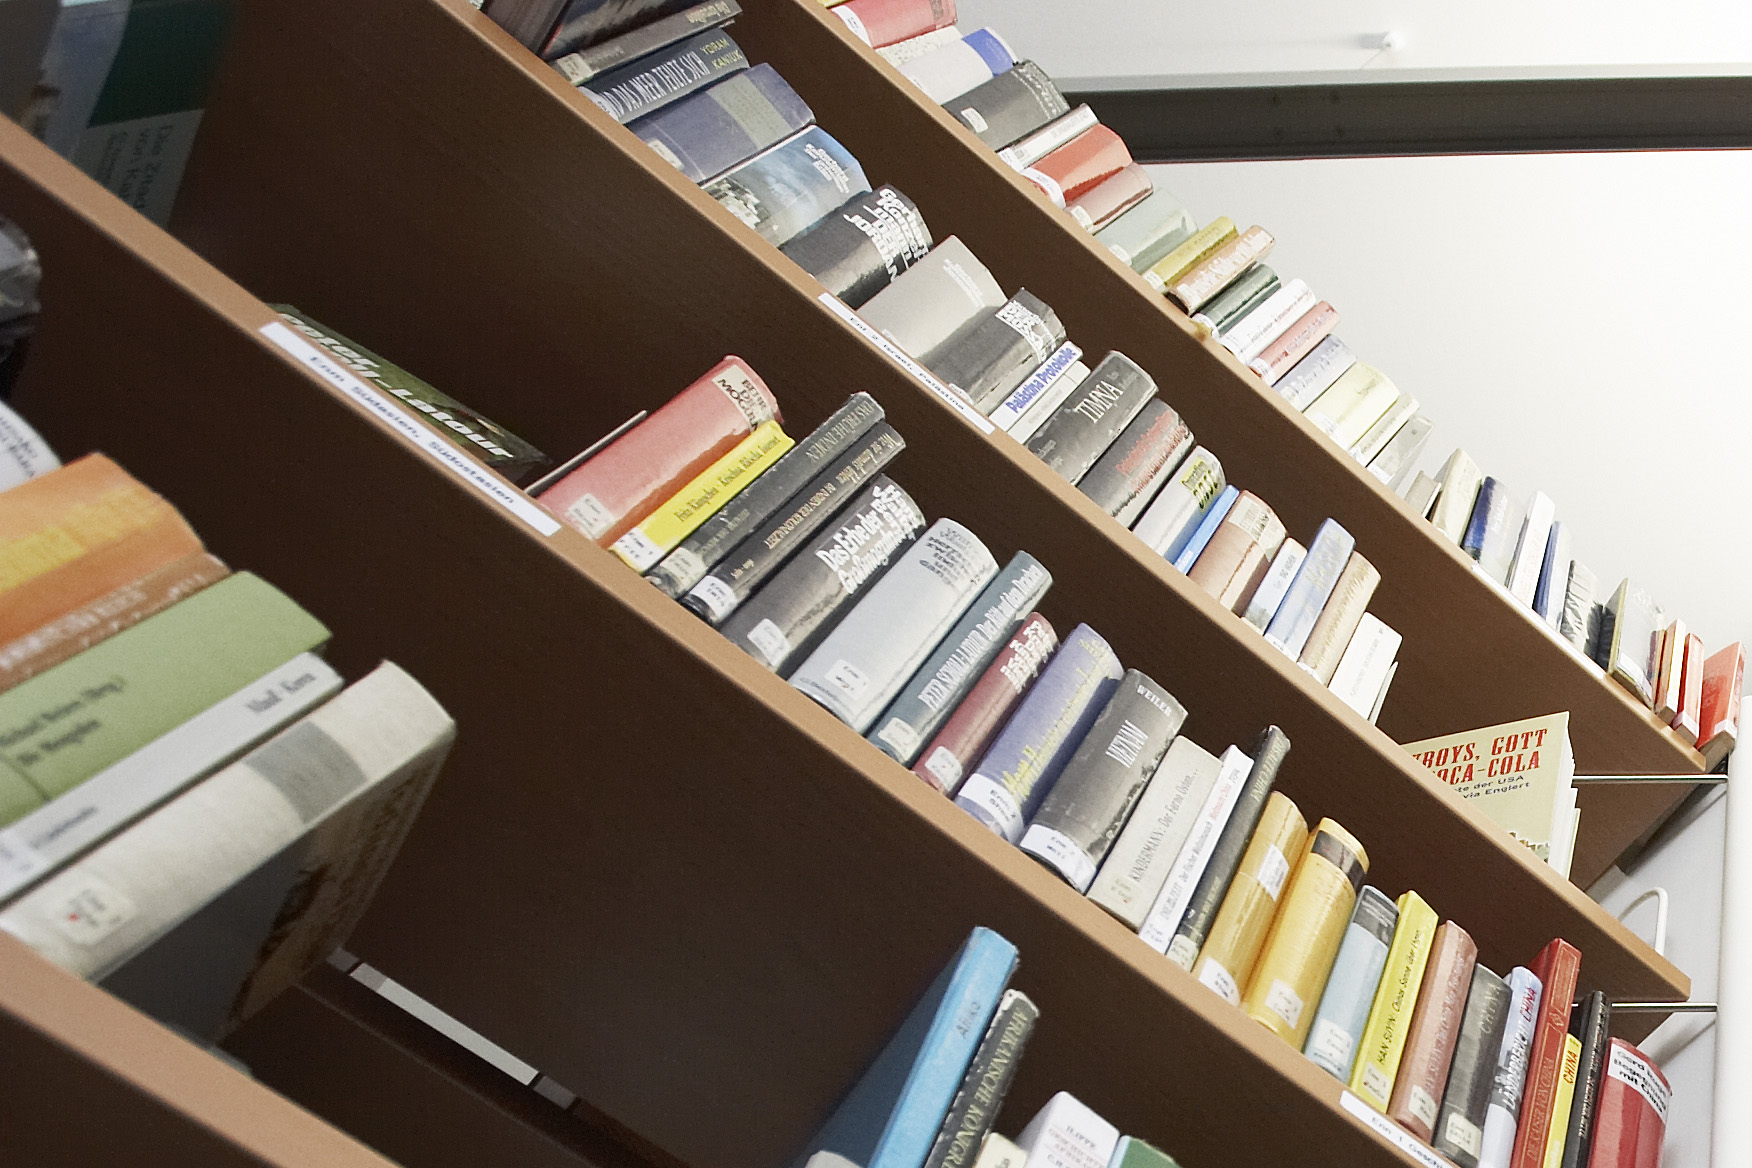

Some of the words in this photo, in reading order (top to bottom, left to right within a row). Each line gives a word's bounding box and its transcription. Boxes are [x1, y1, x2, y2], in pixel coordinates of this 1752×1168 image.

[1004, 377, 1043, 414] Palästina
[1073, 379, 1124, 424] TIMNA
[1491, 728, 1548, 756] GOTT
[1497, 775, 1524, 785] USA
[972, 1005, 1030, 1106] AFRIKANISCHE
